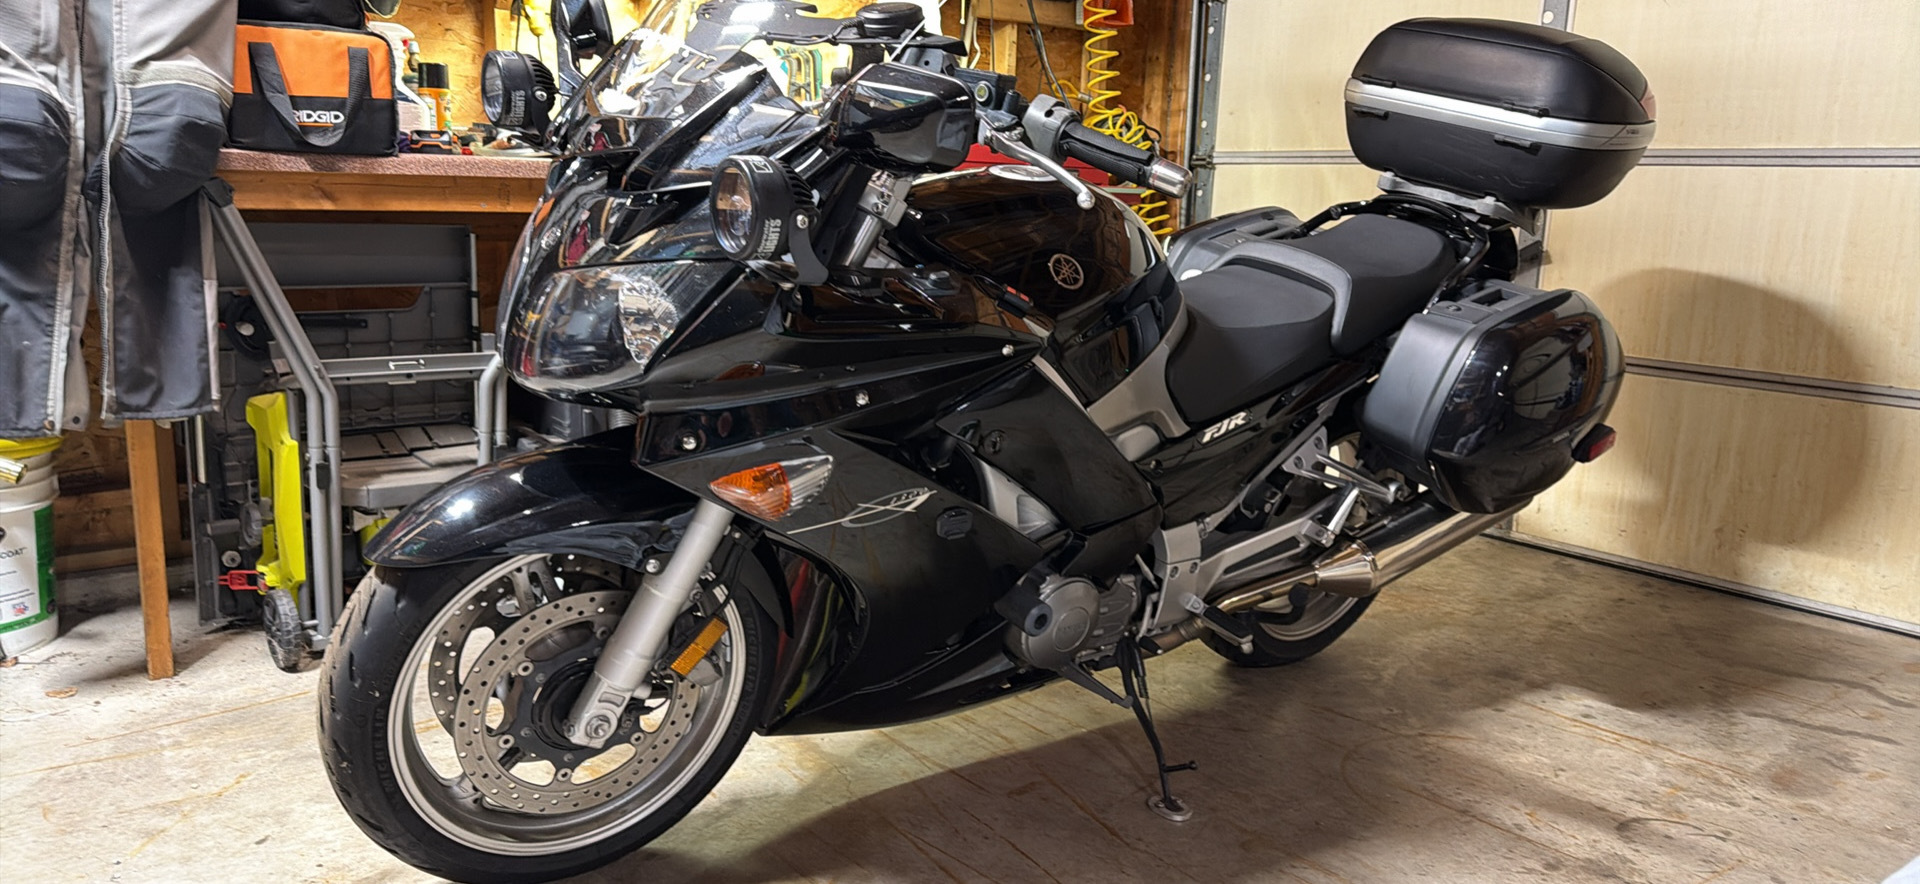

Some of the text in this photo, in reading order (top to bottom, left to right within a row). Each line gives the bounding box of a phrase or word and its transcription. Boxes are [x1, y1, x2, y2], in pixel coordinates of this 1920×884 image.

[762, 218, 782, 252] LIGHTS
[1202, 411, 1247, 443] FJR
[373, 707, 396, 793] MICHELIN
